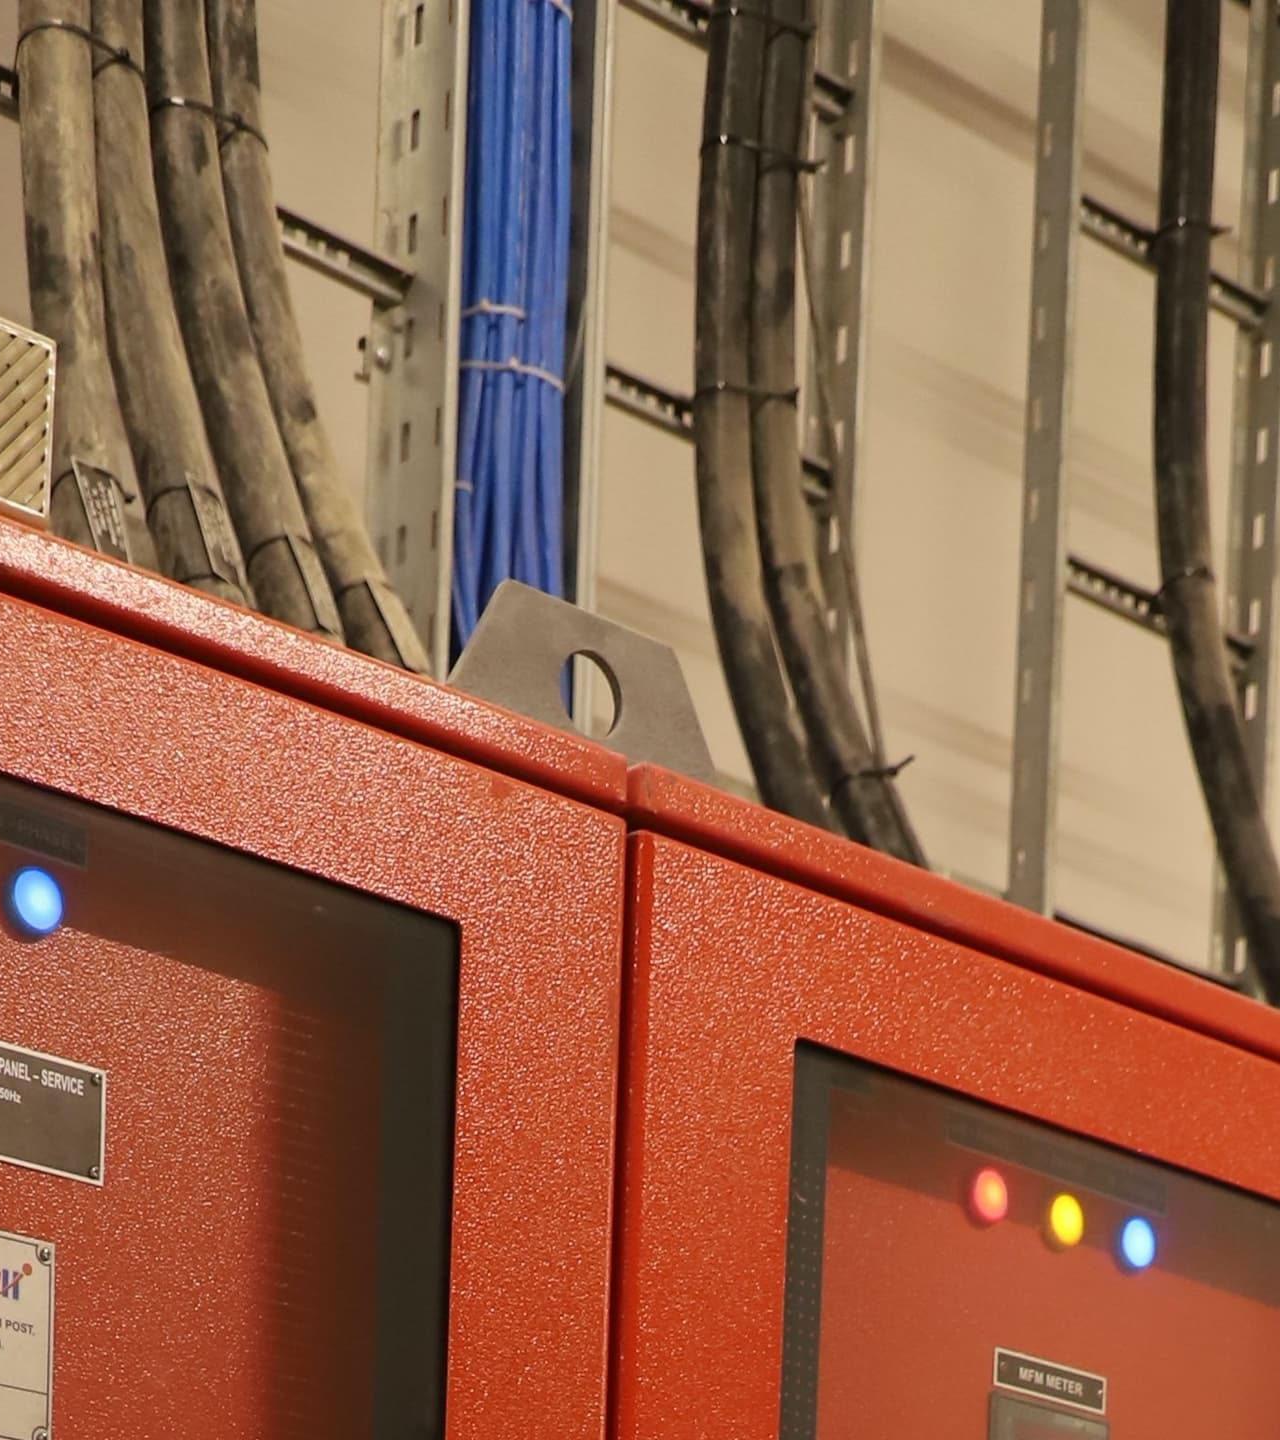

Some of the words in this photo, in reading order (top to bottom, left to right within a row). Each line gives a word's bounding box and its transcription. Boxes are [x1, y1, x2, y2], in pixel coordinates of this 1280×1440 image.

[0, 1088, 22, 1104] 50Hz
[41, 1069, 84, 1096] SERVICE
[1019, 1366, 1044, 1385] MFM
[1046, 1373, 1084, 1396] METER
